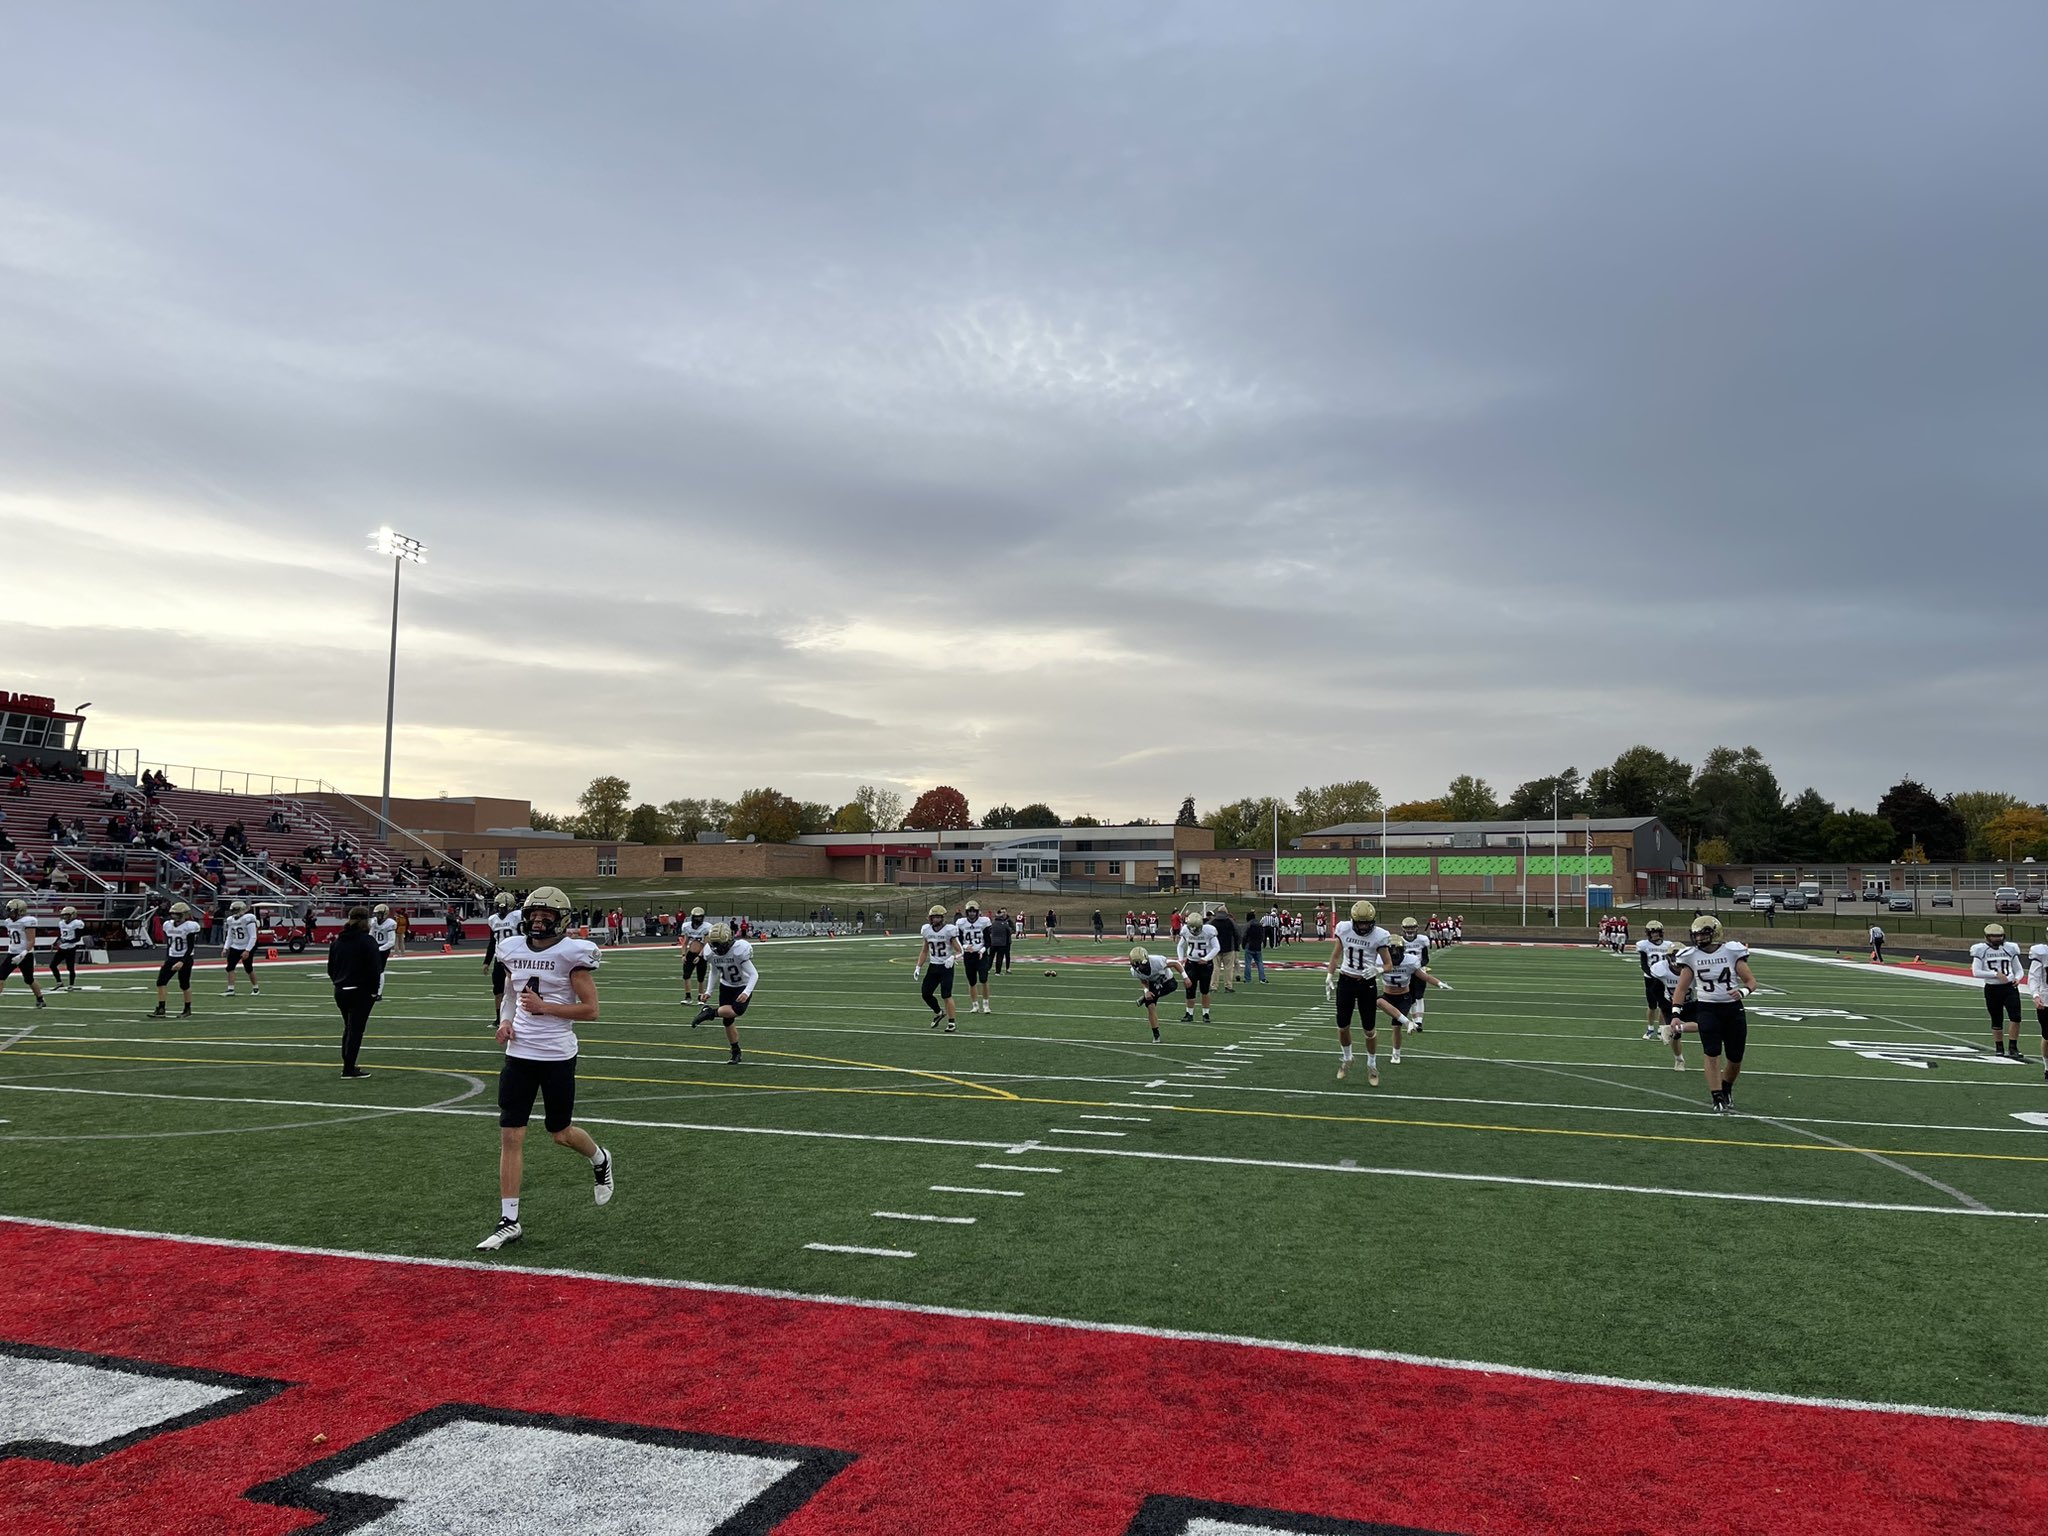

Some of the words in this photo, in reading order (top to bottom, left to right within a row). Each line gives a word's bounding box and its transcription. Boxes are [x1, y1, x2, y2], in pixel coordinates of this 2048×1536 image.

[965, 930, 982, 945] 45
[1188, 942, 1207, 958] 75
[1347, 946, 1365, 970] 11
[513, 959, 556, 971] CAVALIERS
[1697, 957, 1728, 966] CAVALIERS
[1987, 959, 2009, 976] 50
[1697, 966, 1733, 993] 54
[521, 975, 545, 1016] 4
